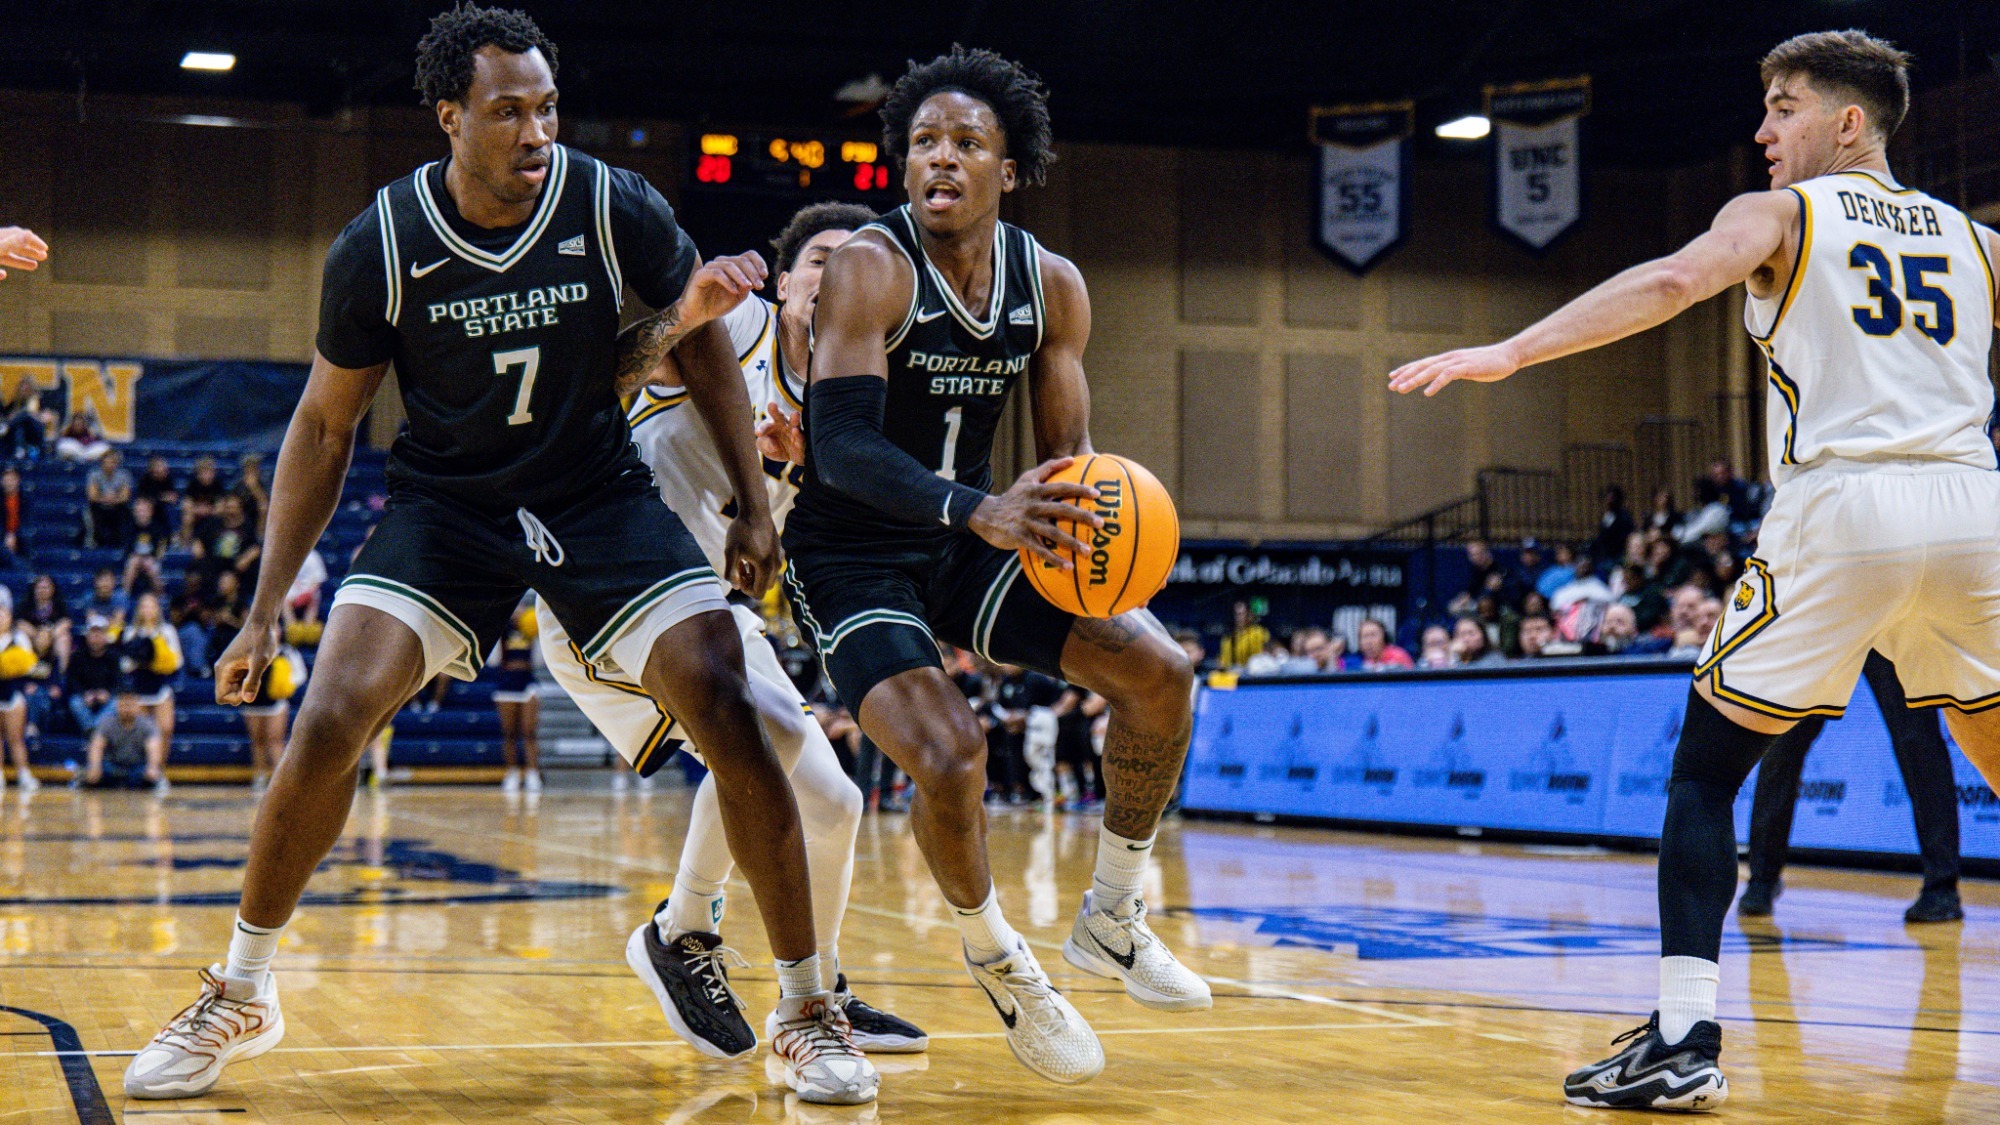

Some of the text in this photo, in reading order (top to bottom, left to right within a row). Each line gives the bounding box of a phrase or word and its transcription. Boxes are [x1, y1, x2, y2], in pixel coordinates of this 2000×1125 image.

[1339, 183, 1382, 212] 55
[1526, 172, 1549, 204] 5
[1837, 191, 1942, 236] DENKER
[428, 281, 589, 323] PORTLAND
[1847, 241, 1957, 347] 35
[463, 307, 559, 338] STATE
[492, 344, 540, 426] 7
[929, 376, 1005, 395] STATE
[935, 405, 963, 481] 1
[1088, 479, 1122, 586] Wilson
